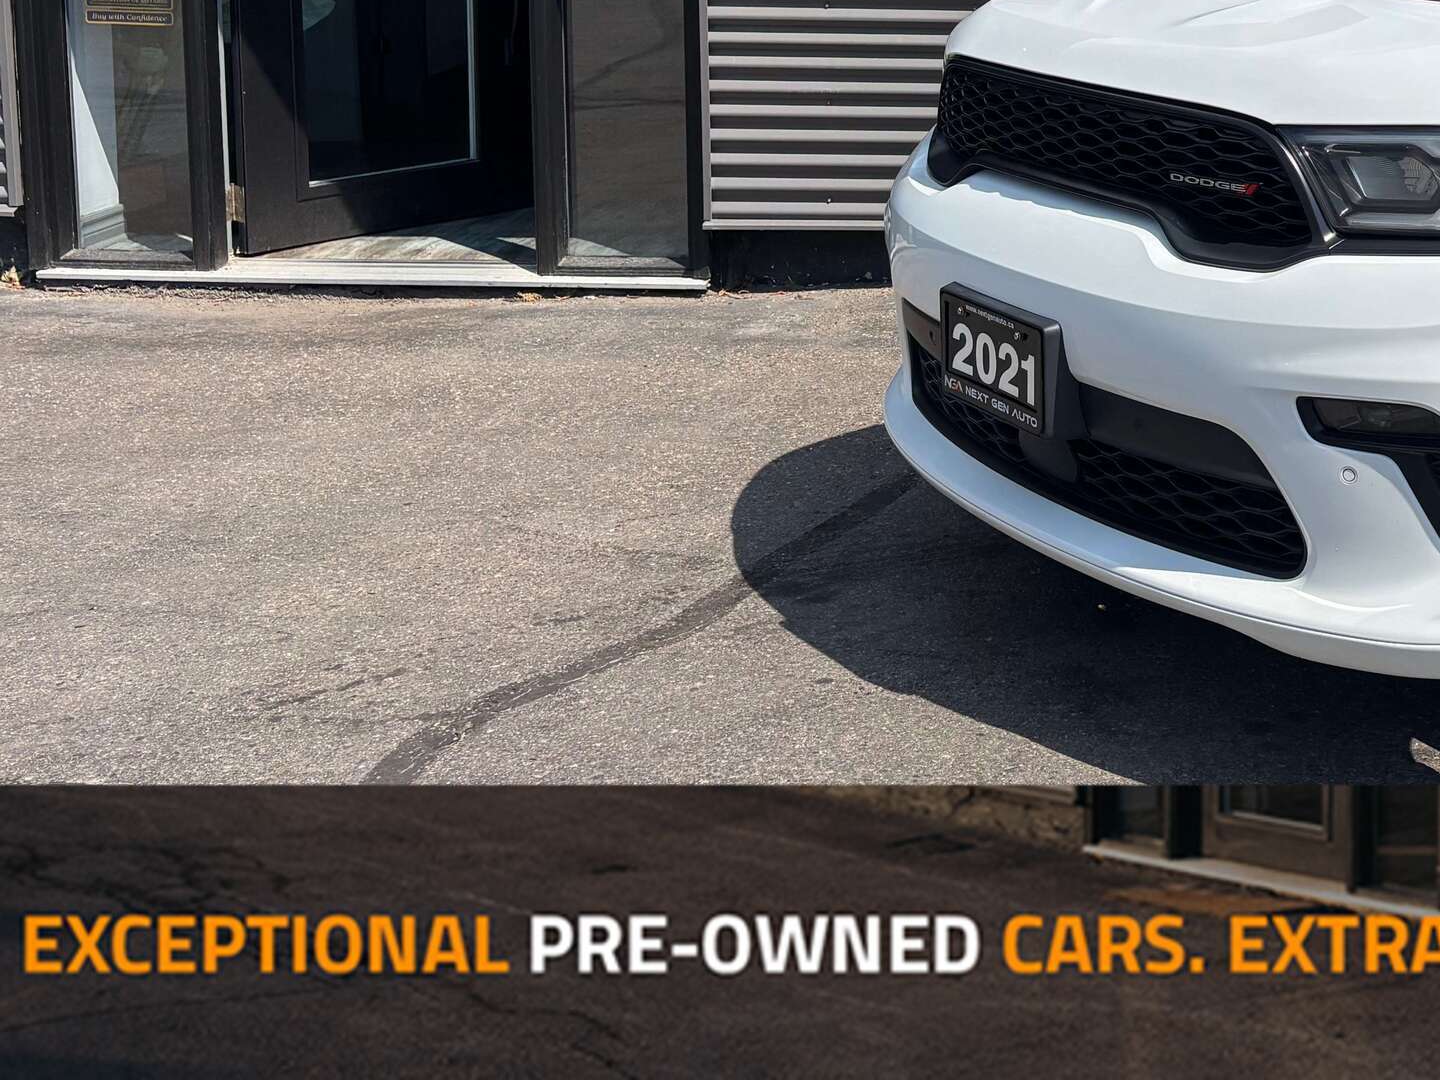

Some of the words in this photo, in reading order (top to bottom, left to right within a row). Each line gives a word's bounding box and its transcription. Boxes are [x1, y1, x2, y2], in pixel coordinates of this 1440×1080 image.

[1169, 173, 1247, 193] DODGE
[951, 322, 1035, 407] 2021
[965, 385, 989, 404] NEXT
[991, 398, 1010, 415] GEN
[1011, 408, 1038, 428] AUTO
